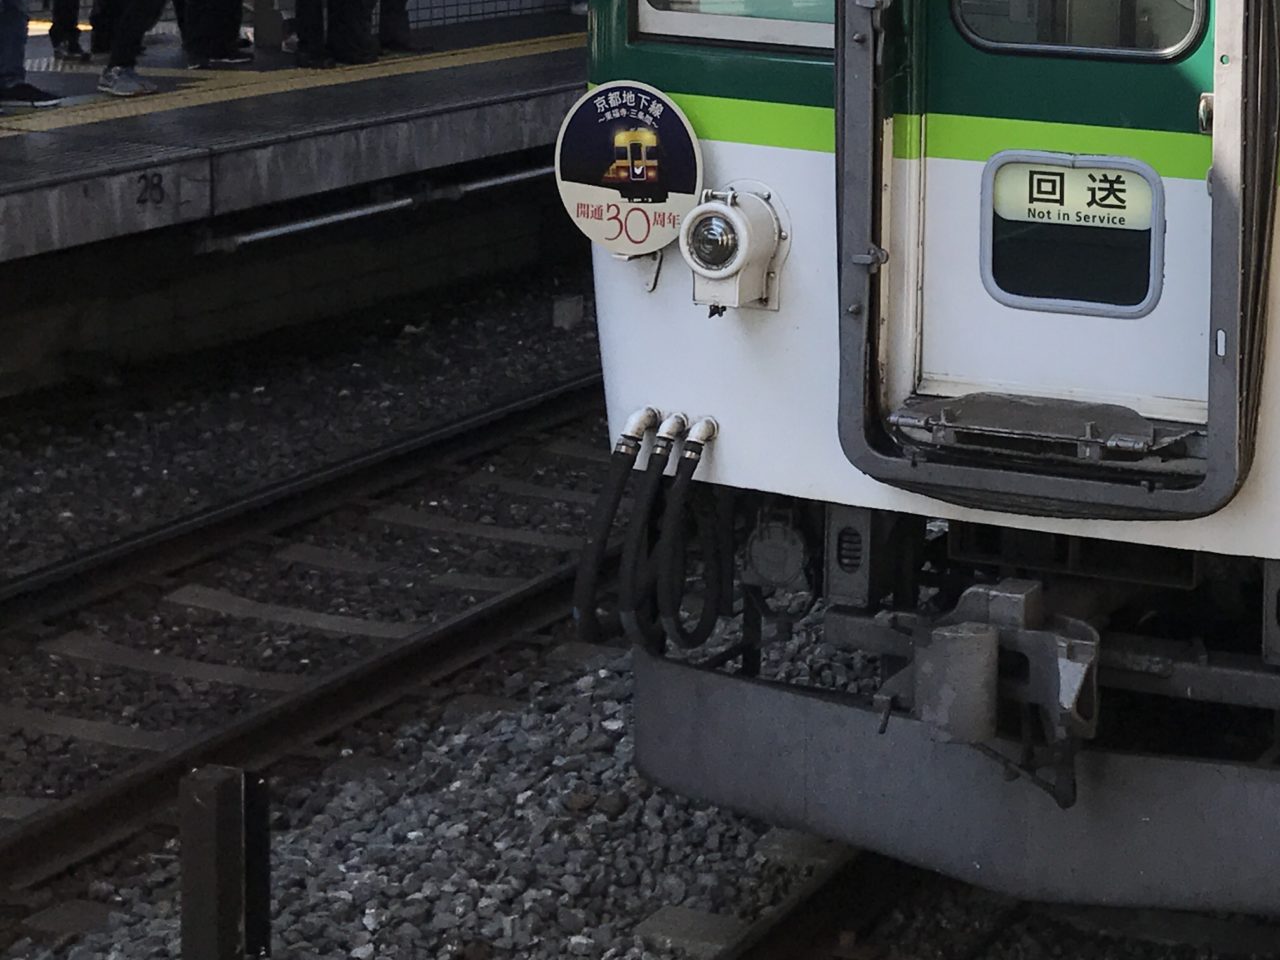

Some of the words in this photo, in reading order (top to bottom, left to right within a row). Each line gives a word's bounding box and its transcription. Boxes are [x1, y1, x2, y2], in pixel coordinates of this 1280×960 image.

[593, 90, 665, 120] 京都地下線
[1027, 208, 1052, 220] Not
[1058, 209, 1070, 221] in
[1075, 211, 1126, 226] Service
